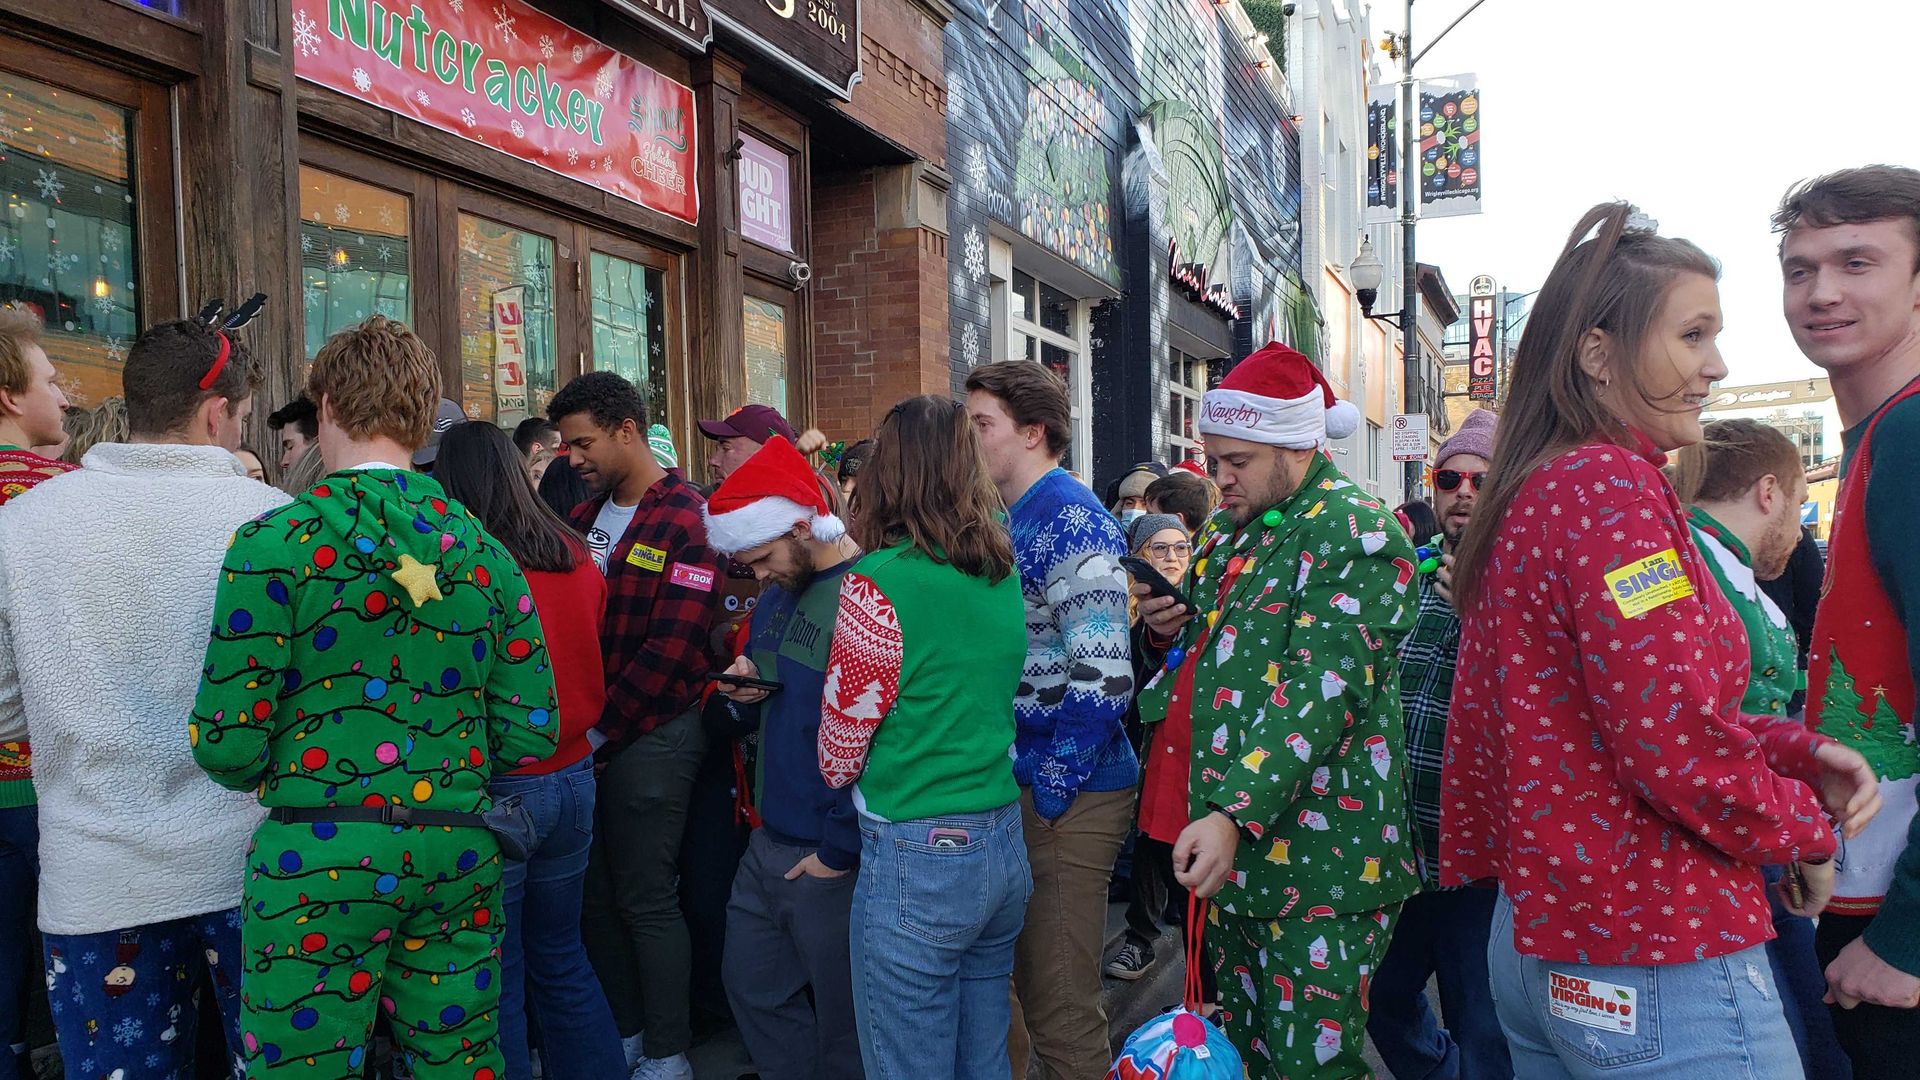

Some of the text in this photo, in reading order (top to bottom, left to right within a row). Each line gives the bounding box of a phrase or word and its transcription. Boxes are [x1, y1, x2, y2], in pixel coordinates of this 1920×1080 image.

[808, 1, 847, 43] 2004
[630, 156, 687, 196] CHEER
[1473, 300, 1493, 376] HVAC
[1201, 401, 1262, 428] Naughty
[632, 547, 664, 564] SINGLE
[1641, 557, 1664, 569] I am
[673, 569, 678, 577] I
[688, 573, 712, 585] TBOX
[1550, 972, 1591, 994] TBOX
[1550, 985, 1604, 1011] VIRGIN
